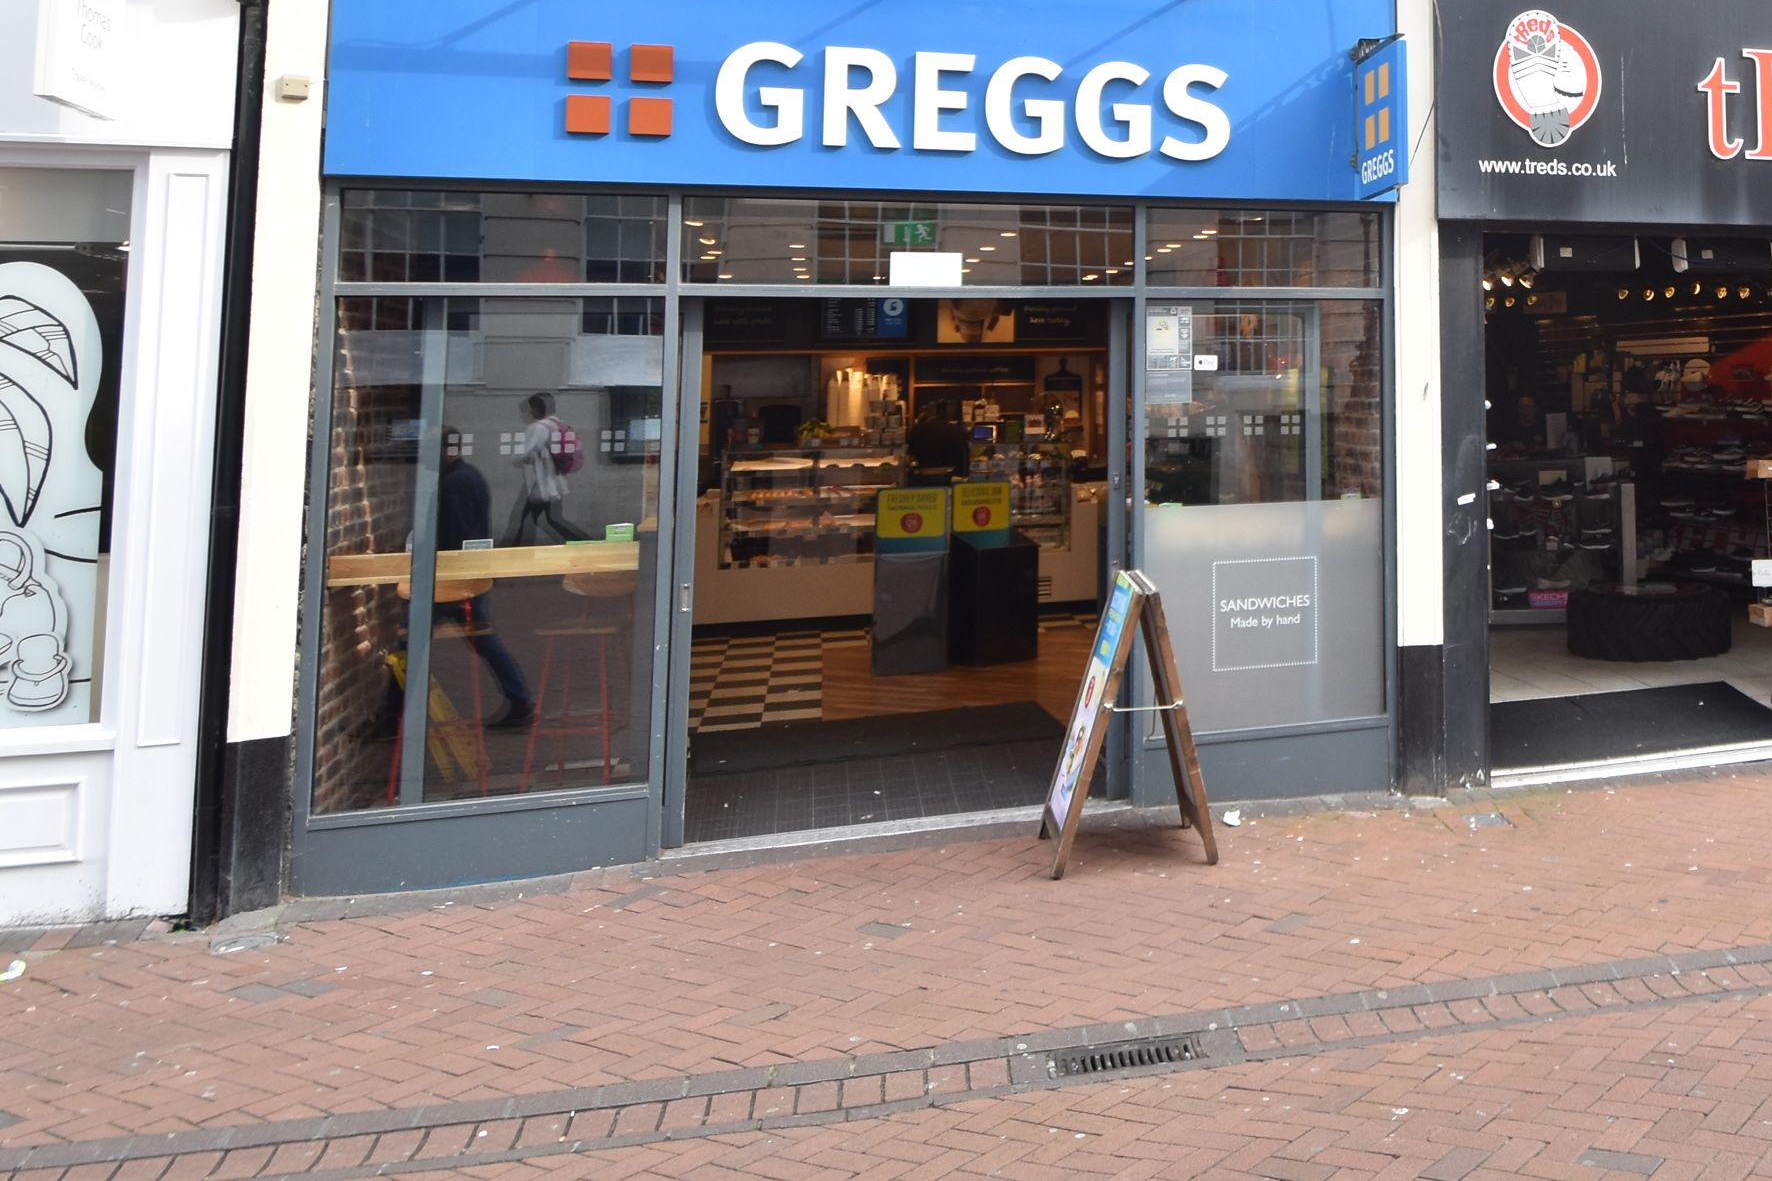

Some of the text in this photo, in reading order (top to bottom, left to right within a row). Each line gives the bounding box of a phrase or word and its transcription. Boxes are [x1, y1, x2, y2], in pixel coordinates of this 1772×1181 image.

[1514, 18, 1555, 45] tReds
[715, 41, 1230, 161] GREGGS
[1361, 149, 1395, 185] GREGGS
[1478, 158, 1617, 177] www.treds.co.uk
[1220, 595, 1310, 612] SANDWICHES
[1230, 613, 1300, 629] Made by hand
